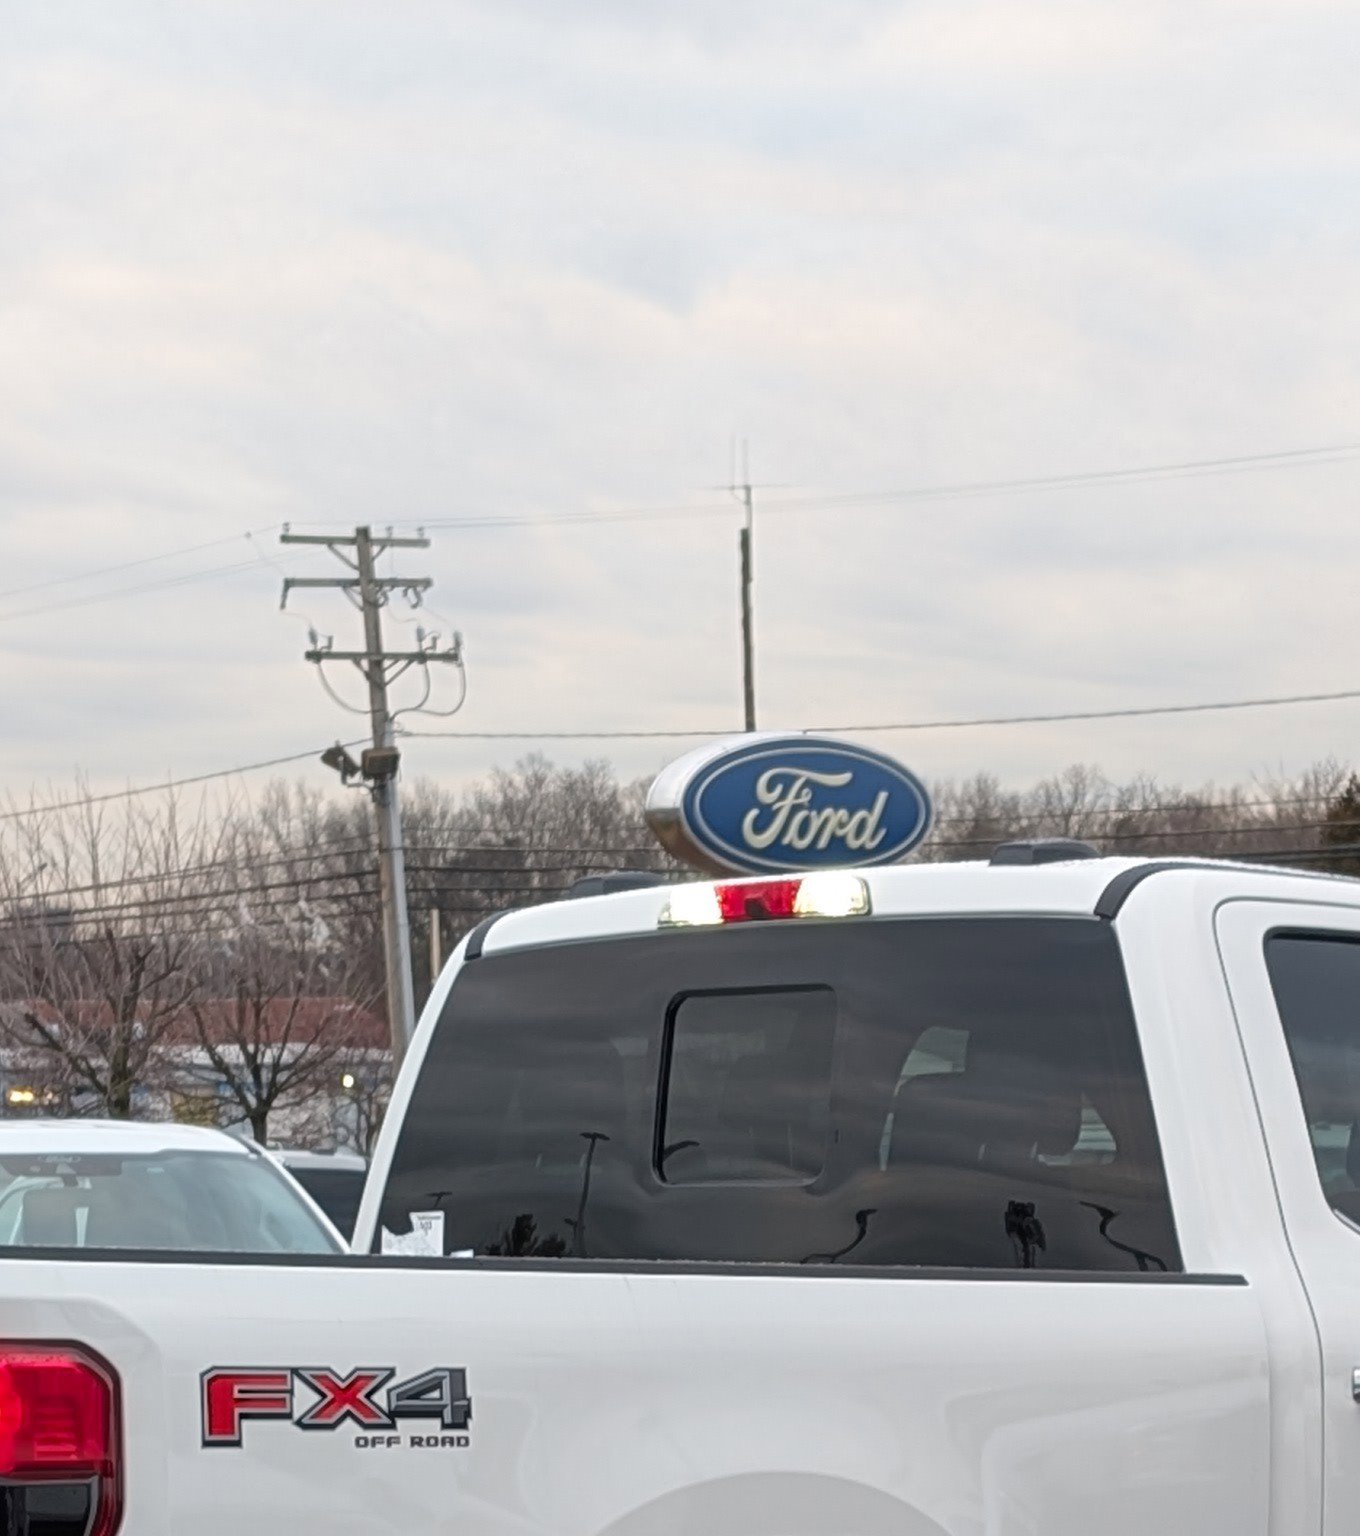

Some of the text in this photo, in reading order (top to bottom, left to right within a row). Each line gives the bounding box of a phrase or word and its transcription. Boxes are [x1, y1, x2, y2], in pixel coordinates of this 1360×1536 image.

[743, 767, 889, 850] Ford
[199, 1366, 472, 1448] FX4
[355, 1435, 470, 1449] OFF ROAD
